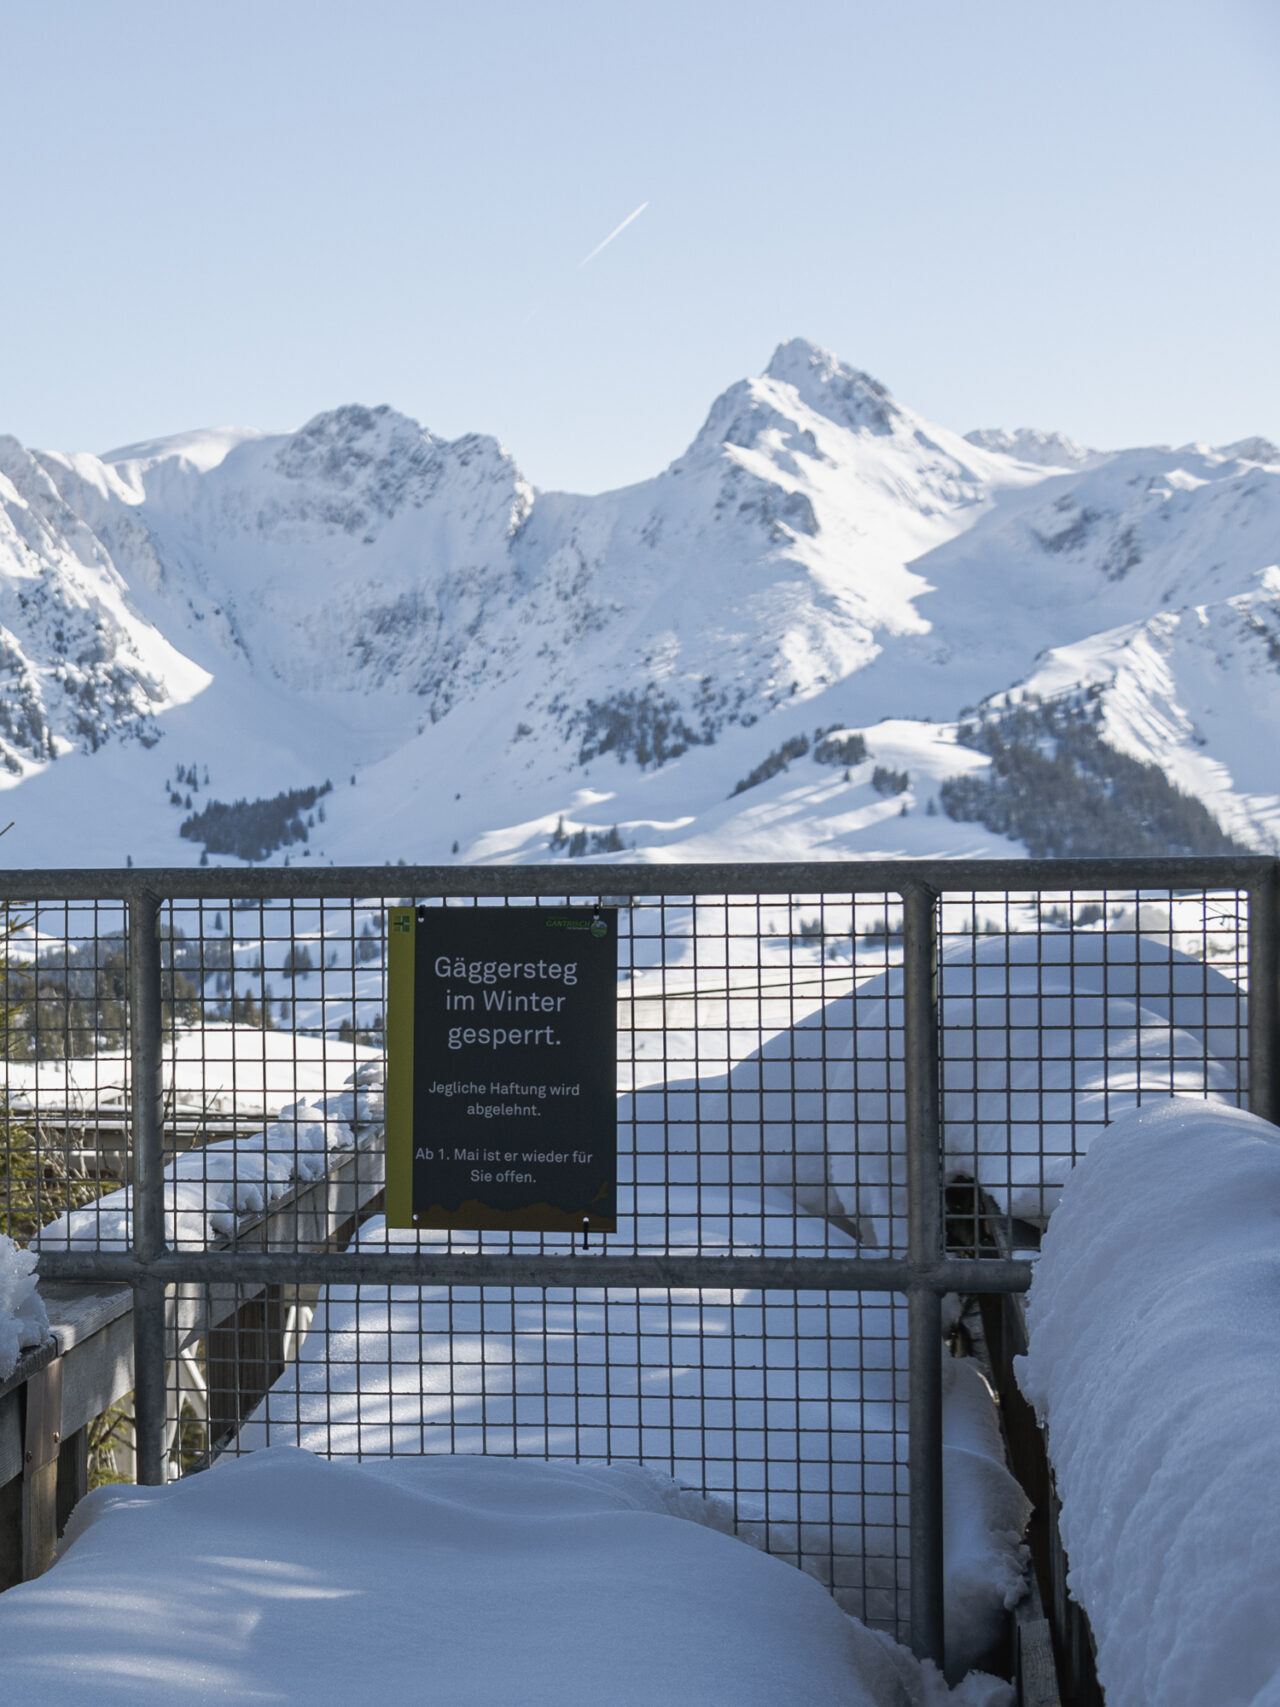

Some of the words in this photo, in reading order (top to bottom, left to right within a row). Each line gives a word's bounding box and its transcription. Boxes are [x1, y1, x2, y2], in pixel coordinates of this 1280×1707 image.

[435, 957, 577, 985] Gäggersteg
[446, 990, 475, 1011] im
[483, 990, 566, 1011] Winter
[448, 1026, 560, 1049] gesperrt.
[428, 1081, 487, 1097] Jegliche
[490, 1082, 547, 1099] Haftung
[549, 1083, 581, 1096] wird
[466, 1103, 541, 1119] abgelehnt.
[415, 1148, 434, 1160] Ab
[438, 1148, 451, 1162] 1.
[454, 1149, 479, 1161] Mai
[483, 1149, 501, 1162] ist
[503, 1153, 519, 1162] er
[521, 1150, 569, 1163] wieder
[572, 1151, 593, 1164] für
[470, 1170, 493, 1183] Sie
[495, 1170, 537, 1184] offen.
